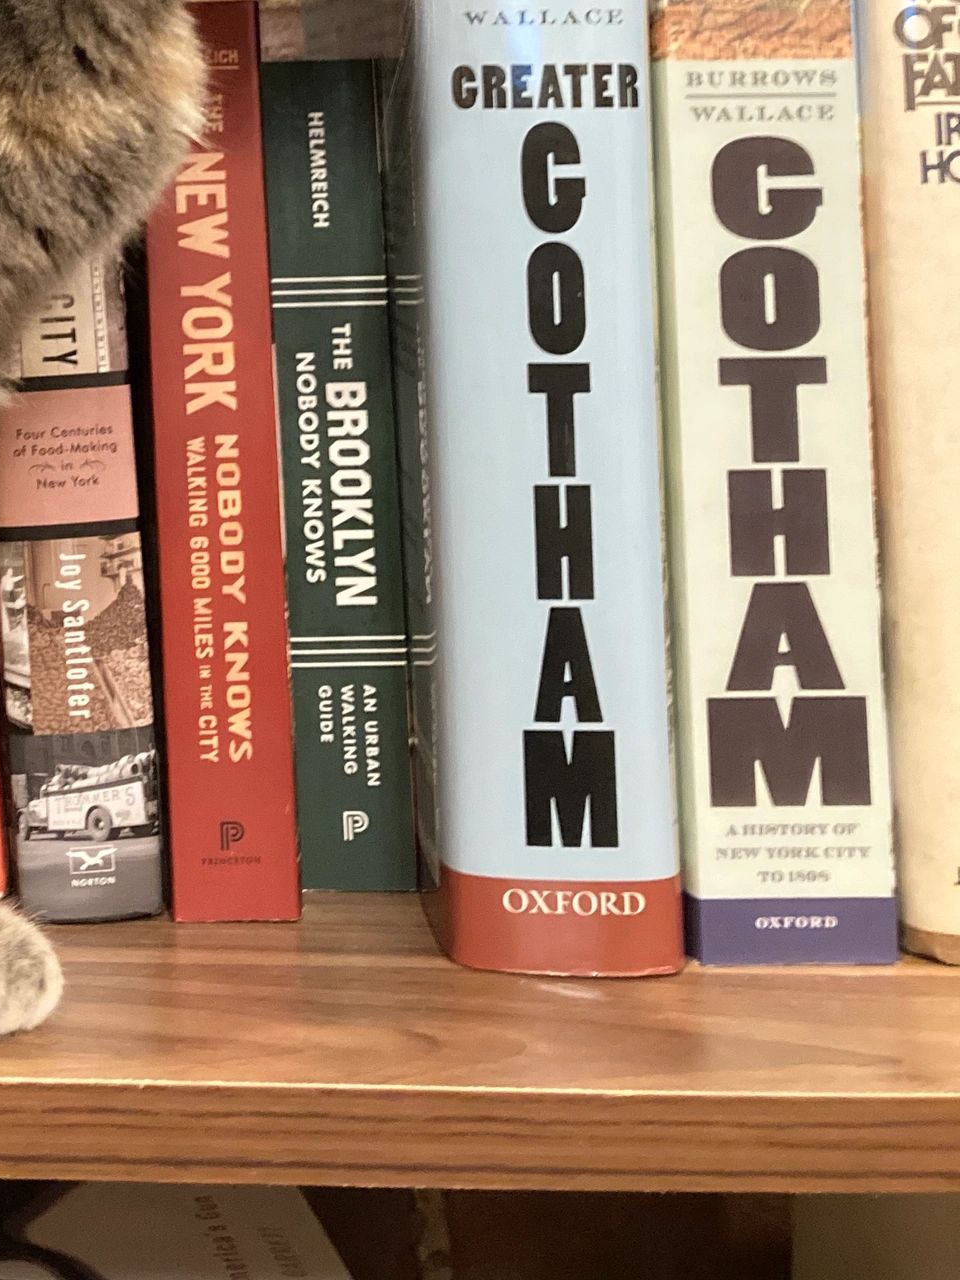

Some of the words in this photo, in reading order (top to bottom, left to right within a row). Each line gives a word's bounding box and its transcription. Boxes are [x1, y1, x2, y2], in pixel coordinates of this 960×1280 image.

[464, 9, 624, 27] WALLACE
[894, 6, 956, 50] OF
[451, 64, 640, 109] GREATER
[685, 69, 838, 90] BURROWS
[689, 104, 835, 122] WALLACE
[307, 111, 331, 229] HELMREICH
[174, 152, 232, 259] NEW
[40, 293, 78, 366] CITY
[180, 272, 238, 415] YORK
[331, 322, 353, 371] THE
[15, 426, 45, 441] Four
[50, 424, 114, 439] Centuries
[295, 351, 321, 469] NOBODY
[12, 445, 27, 458] of
[30, 441, 118, 458] Food-Making
[60, 459, 74, 471] in
[707, 136, 873, 808] GOTHAM
[36, 477, 67, 490] New
[70, 475, 101, 488] York
[186, 436, 209, 528] WALKING
[324, 381, 378, 607] BROOKLYN
[520, 122, 620, 848] GOTHAM
[214, 433, 247, 606] NOBODY
[301, 478, 327, 584] KNOWS
[55, 552, 87, 591] Joy
[189, 536, 211, 590] 6000
[193, 597, 214, 660] MILES
[62, 599, 94, 720] Santlofer
[198, 665, 212, 680] IN
[199, 685, 214, 709] THE
[222, 621, 254, 764] KNOWS
[317, 684, 334, 743] GUIDE
[363, 684, 378, 713] AN
[198, 715, 220, 763] CITY
[340, 684, 359, 776] WALKING
[364, 720, 381, 787] URBAN
[716, 847, 761, 861] NEW
[766, 846, 819, 860] YORK
[823, 846, 871, 859] CITY
[725, 824, 738, 837] A
[740, 823, 828, 837] HISTORY
[832, 822, 858, 836] OF
[70, 875, 118, 890] NORTON
[757, 870, 785, 883] TO
[502, 888, 646, 917] OXFORD
[755, 915, 838, 930] OXFORD
